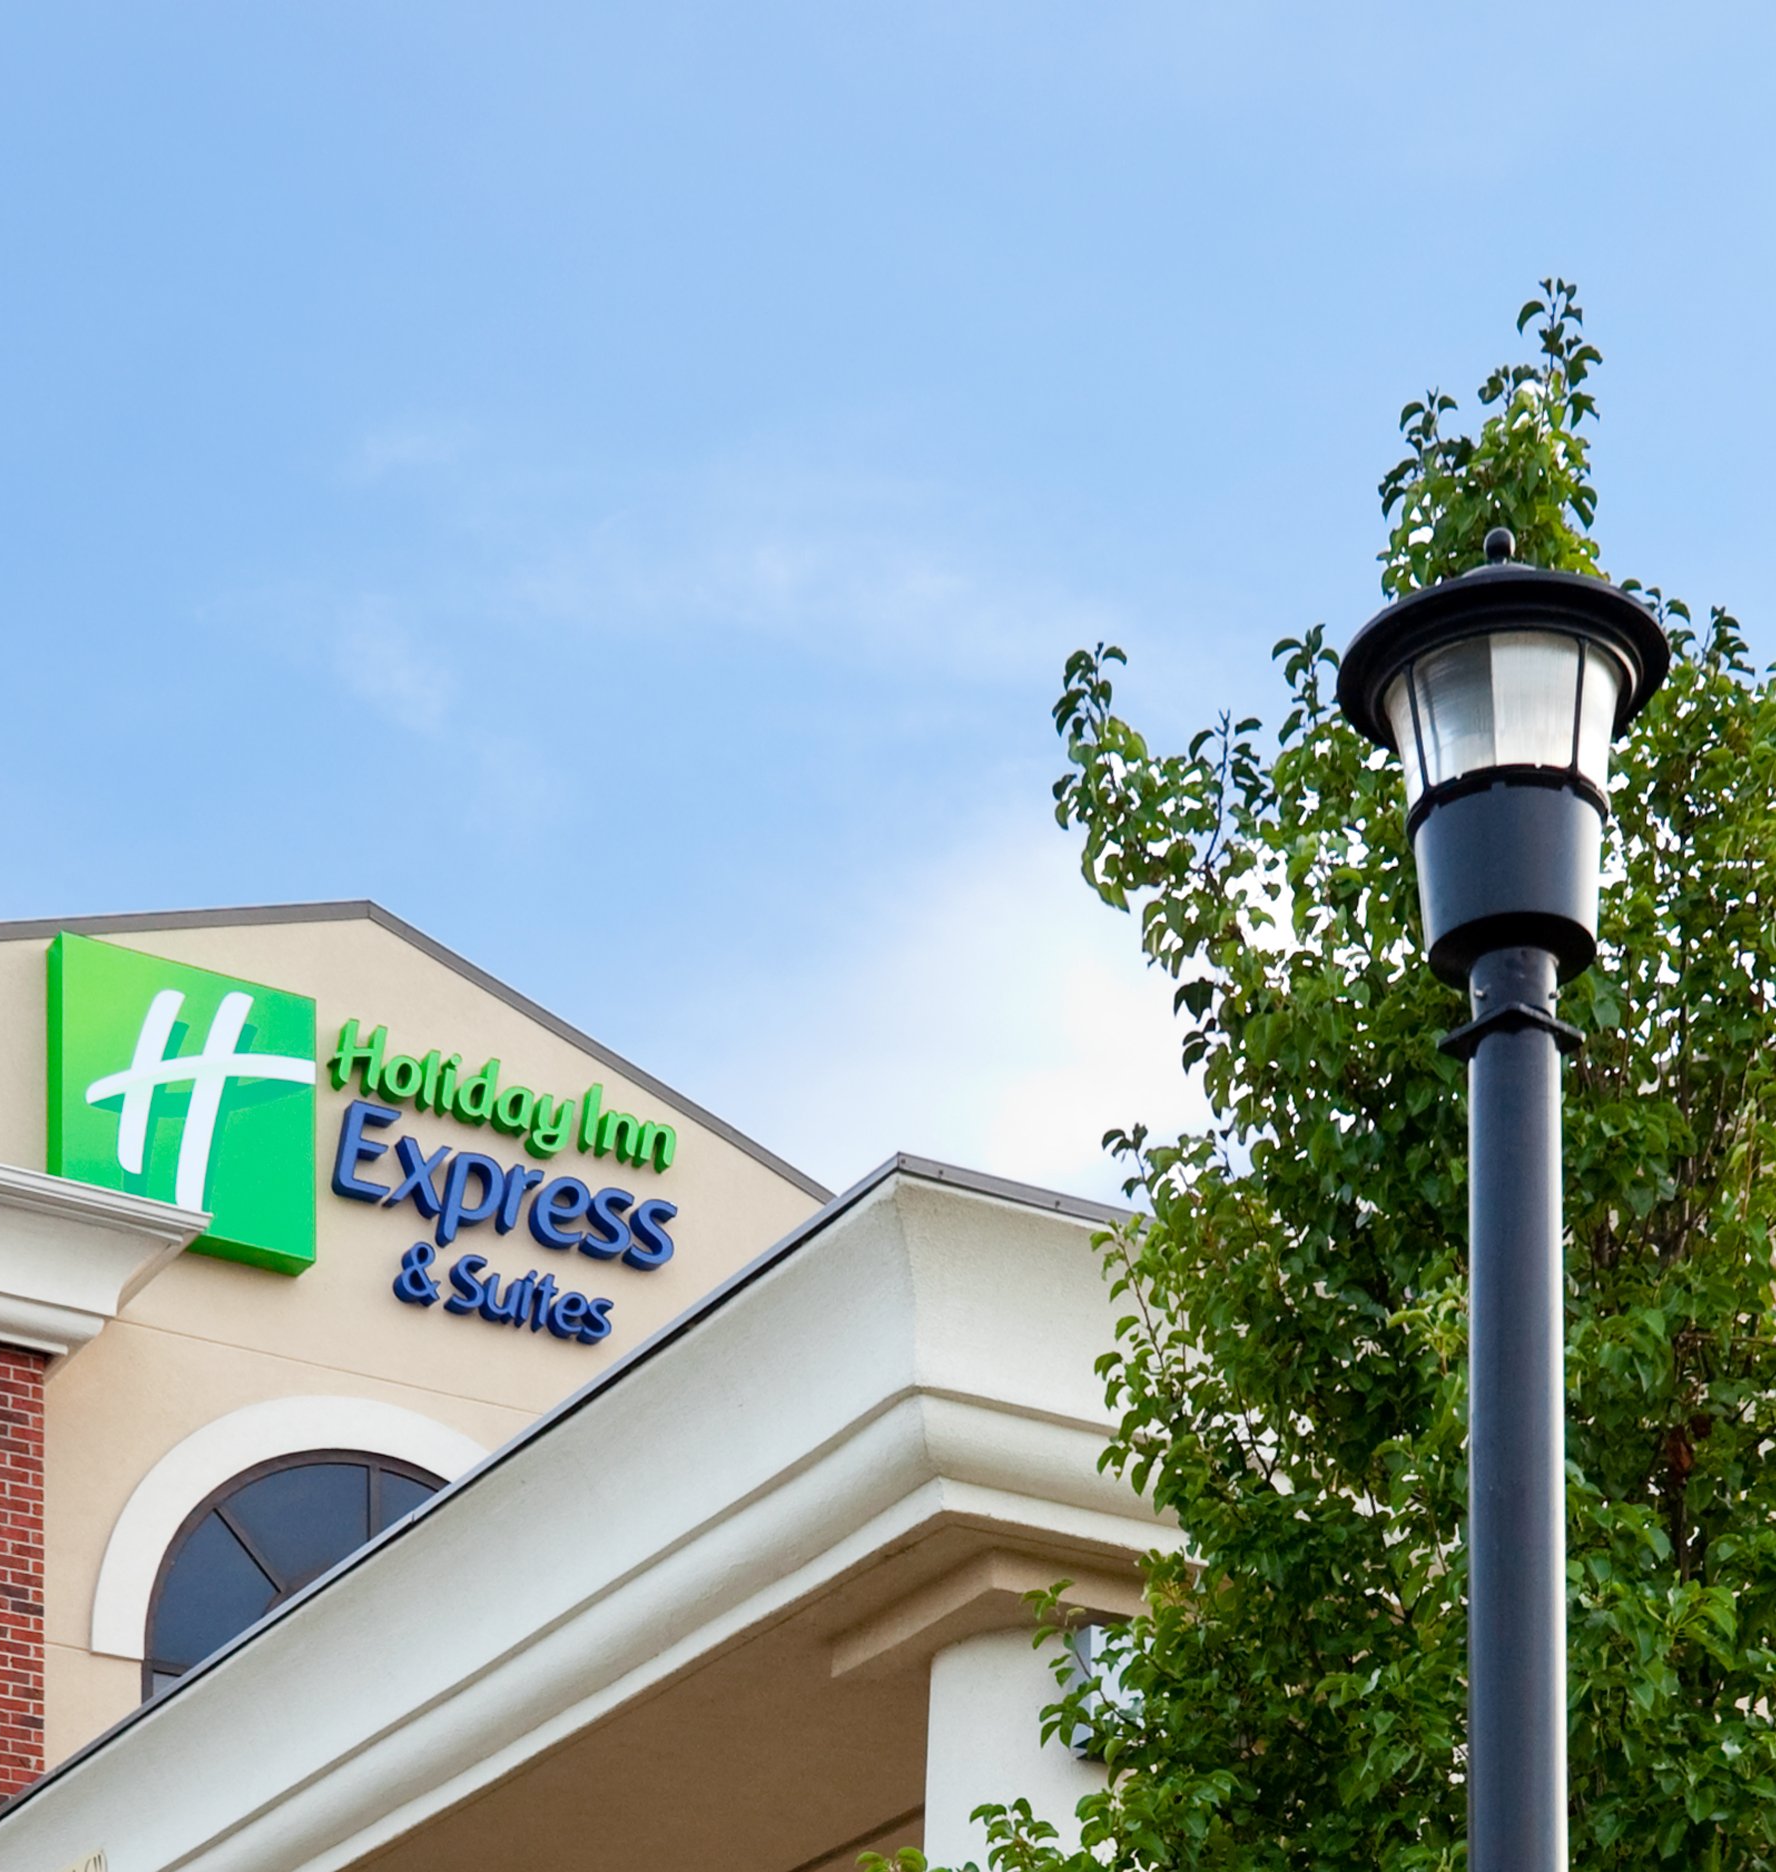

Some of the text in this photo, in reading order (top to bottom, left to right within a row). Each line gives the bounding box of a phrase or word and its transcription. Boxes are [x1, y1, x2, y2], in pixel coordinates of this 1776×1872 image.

[327, 1018, 677, 1174] Holiday Inn
[332, 1100, 678, 1272] Express
[393, 1241, 614, 1345] & Suites
